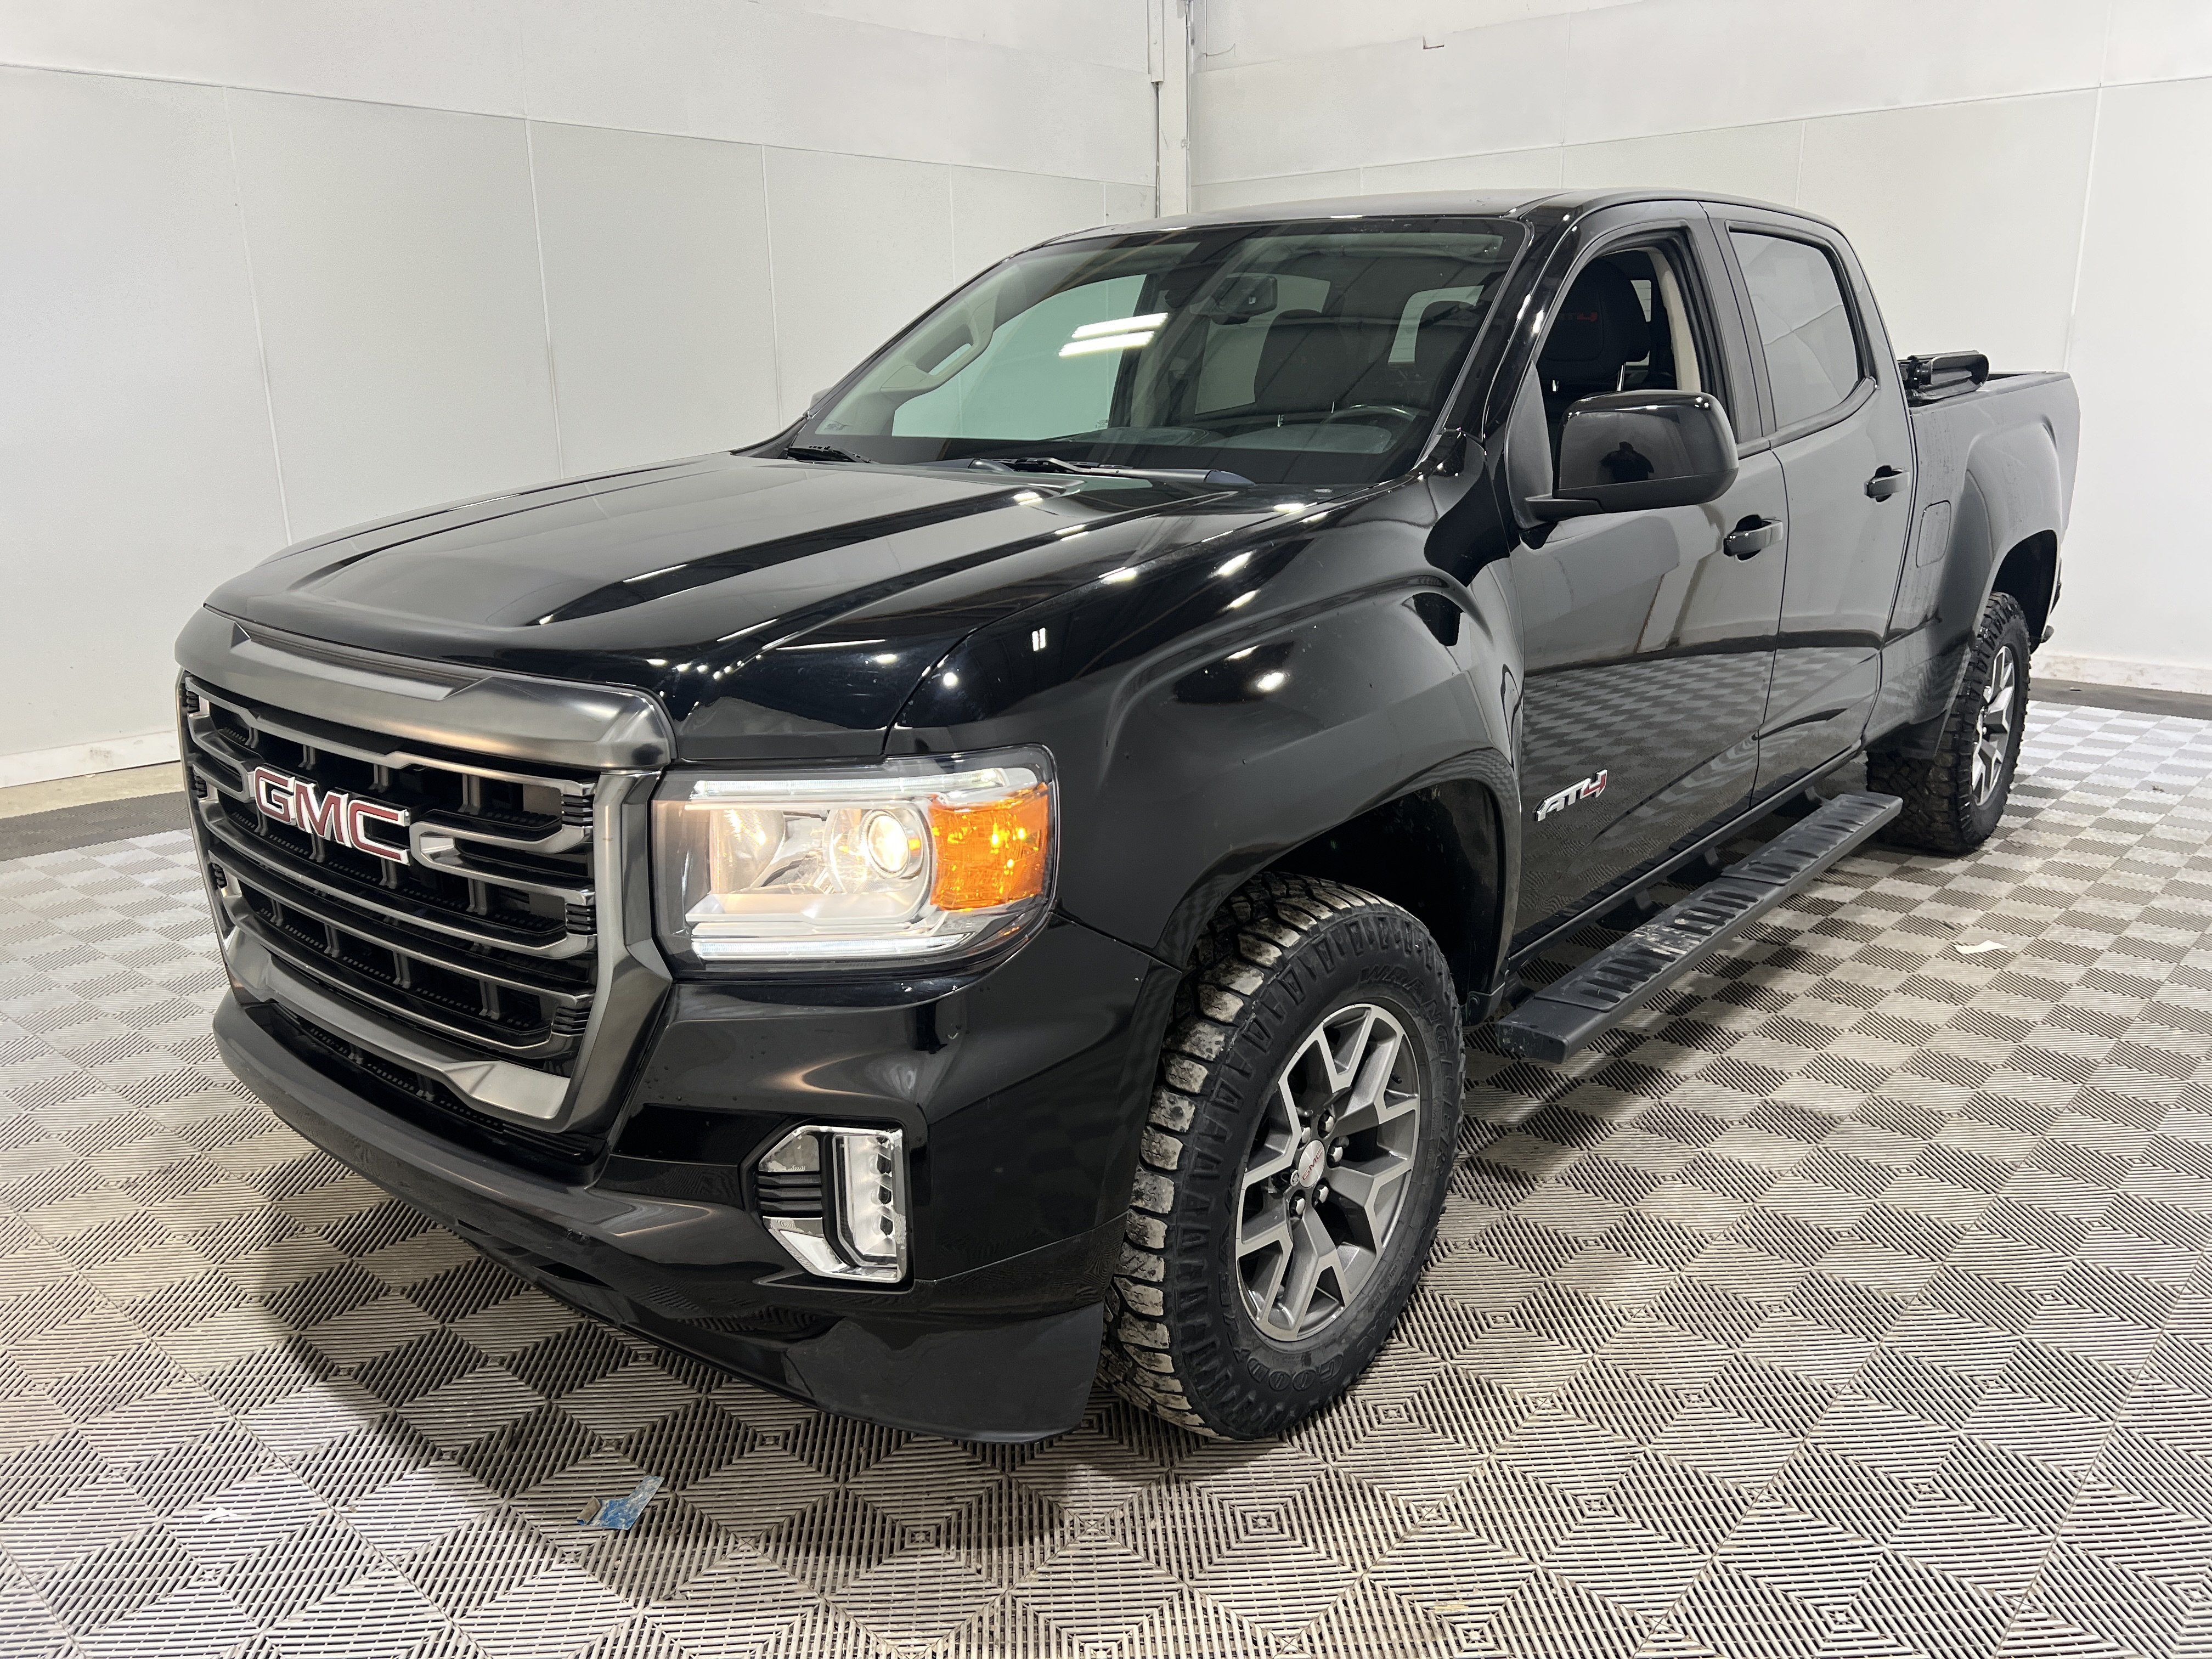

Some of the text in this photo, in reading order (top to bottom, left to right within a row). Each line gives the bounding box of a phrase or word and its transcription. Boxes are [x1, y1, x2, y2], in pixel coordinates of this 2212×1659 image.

[254, 764, 410, 866] GMC
[1534, 769, 1608, 822] AT4
[1360, 964, 1454, 1176] WRANGLER
[1302, 1147, 1323, 1181] GMC
